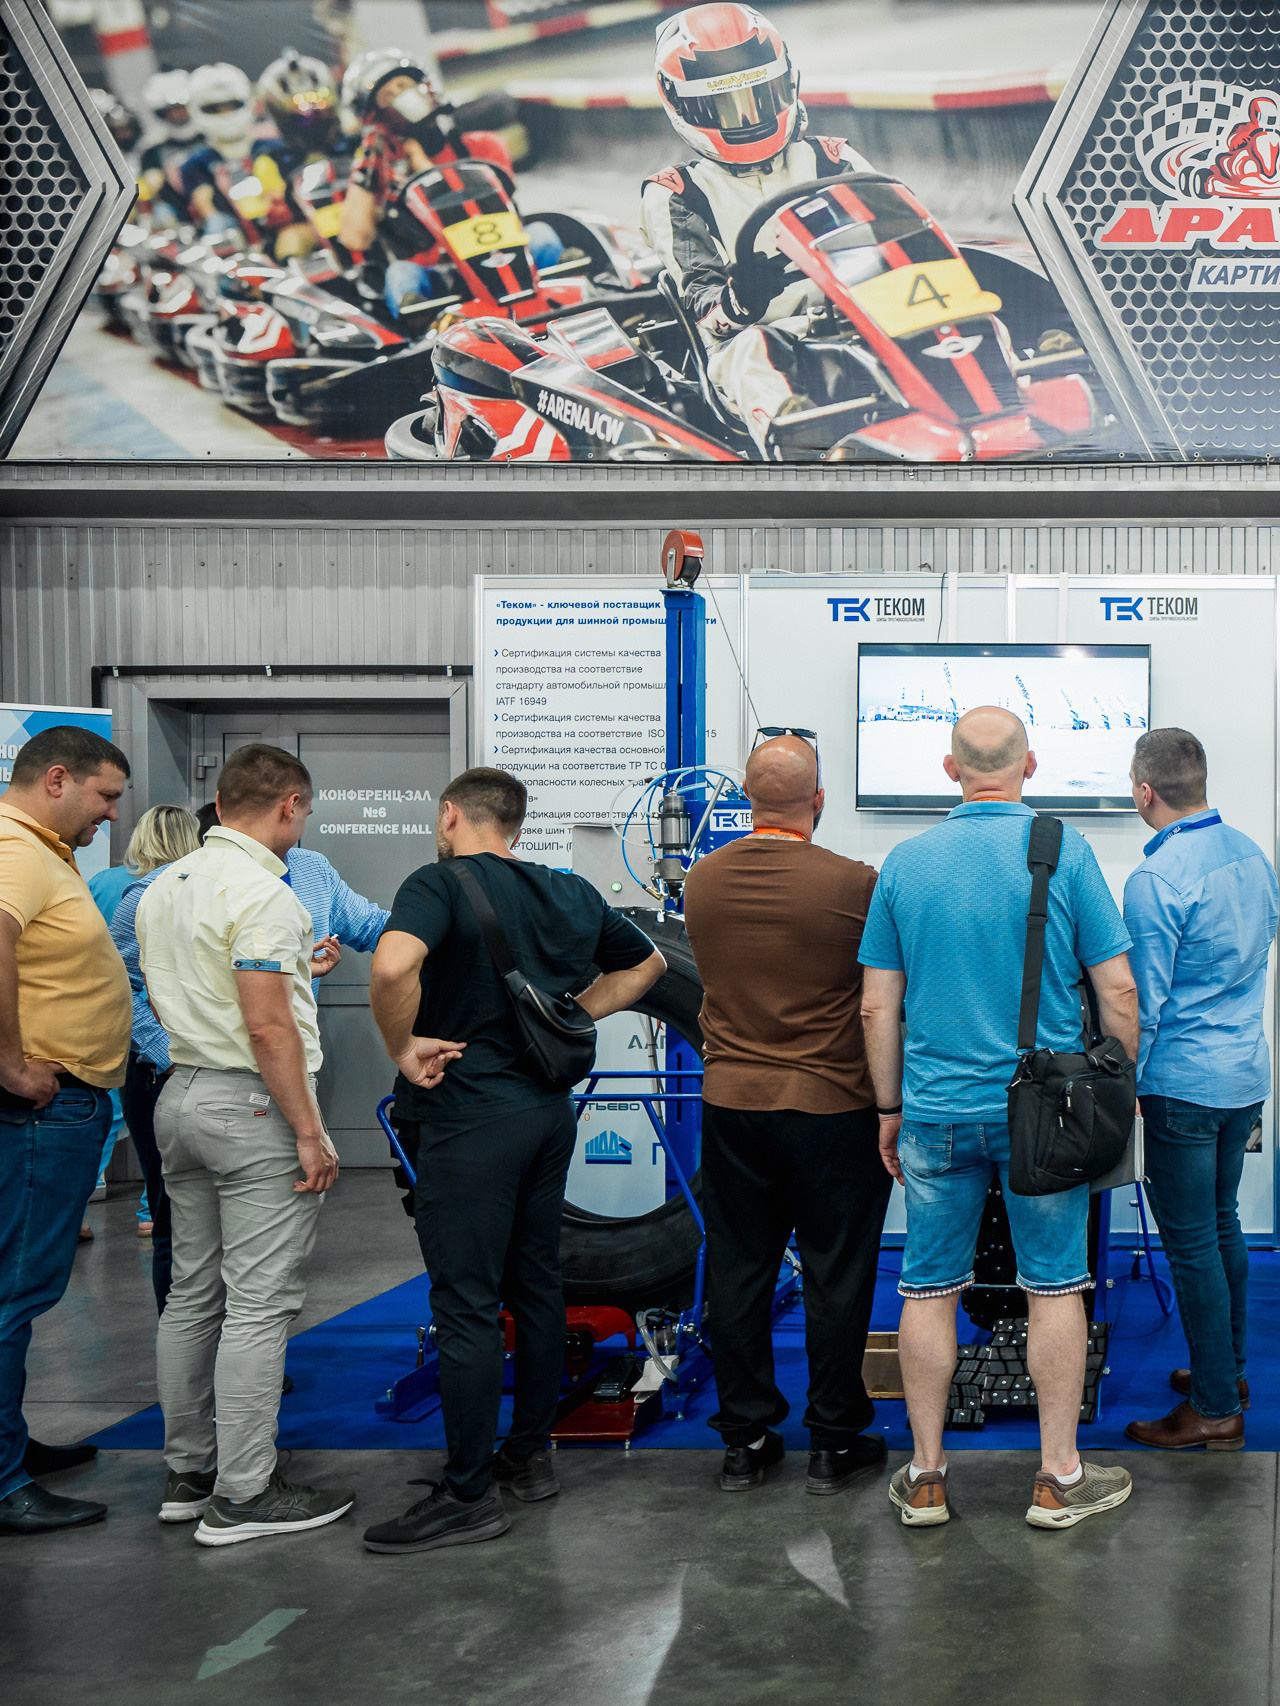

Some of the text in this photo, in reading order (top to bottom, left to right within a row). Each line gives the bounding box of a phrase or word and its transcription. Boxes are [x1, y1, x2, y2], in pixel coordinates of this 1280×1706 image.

[472, 214, 503, 246] 8
[908, 274, 950, 309] 4
[537, 389, 624, 445] #ARENAJCW
[496, 600, 536, 608] «Теком»
[603, 601, 660, 609] поставщик
[874, 598, 925, 616] ТЕКОМ
[1147, 597, 1198, 615] ТЕКОМ
[497, 618, 552, 626] продукции
[556, 618, 574, 626] для
[502, 648, 571, 658] Сертификация
[496, 666, 562, 675] производства
[496, 682, 543, 691] стандарту
[547, 680, 620, 689] автомобильной
[496, 696, 546, 705] IATF 16949
[502, 712, 573, 723] Сертификация
[496, 730, 561, 739] производства
[649, 728, 666, 740] ISO
[502, 743, 666, 757] Сертификация качества основной
[496, 761, 546, 771] продукции
[629, 761, 641, 769] ТР
[644, 761, 657, 770] ТС
[318, 789, 431, 803] КОНФЕРЕНЦ-ЗАЛ
[363, 807, 386, 818] №6
[574, 810, 637, 818] соответствия
[319, 823, 432, 835] CONFERENCE HALL
